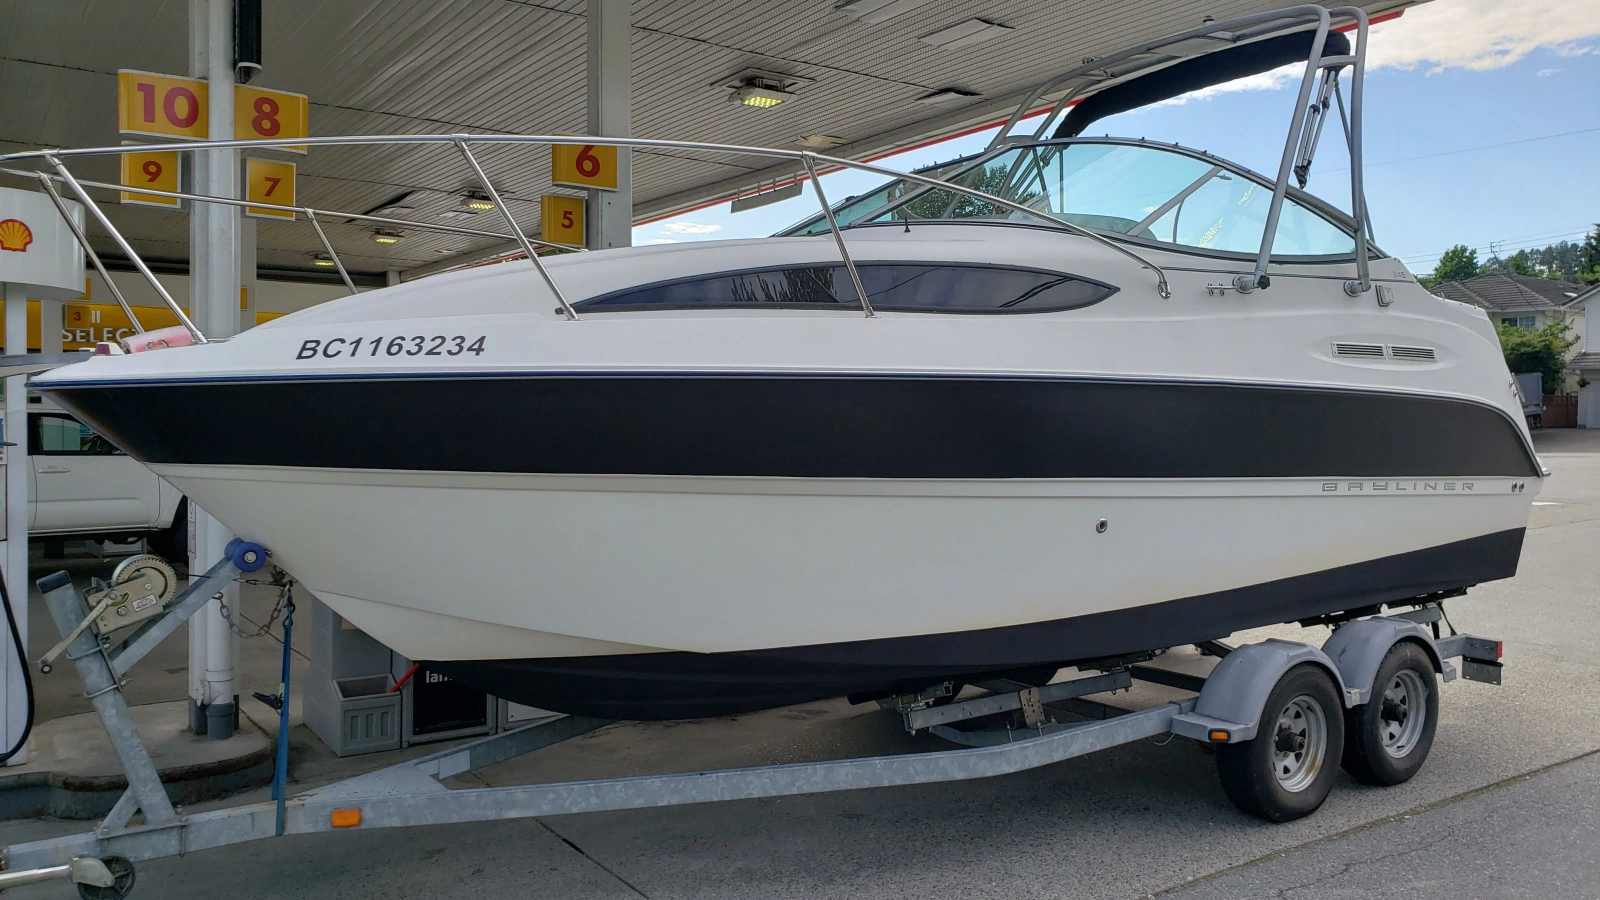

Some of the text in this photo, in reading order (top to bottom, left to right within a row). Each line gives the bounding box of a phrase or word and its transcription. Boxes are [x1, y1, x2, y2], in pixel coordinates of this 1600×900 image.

[137, 82, 200, 129] 10
[251, 96, 281, 137] 8
[142, 160, 163, 183] 9
[575, 145, 601, 178] 6
[263, 176, 282, 197] 7
[561, 210, 574, 230] 5
[73, 311, 82, 321] 3
[295, 335, 487, 360] BC1163234
[1321, 482, 1475, 492] BAYLINER
